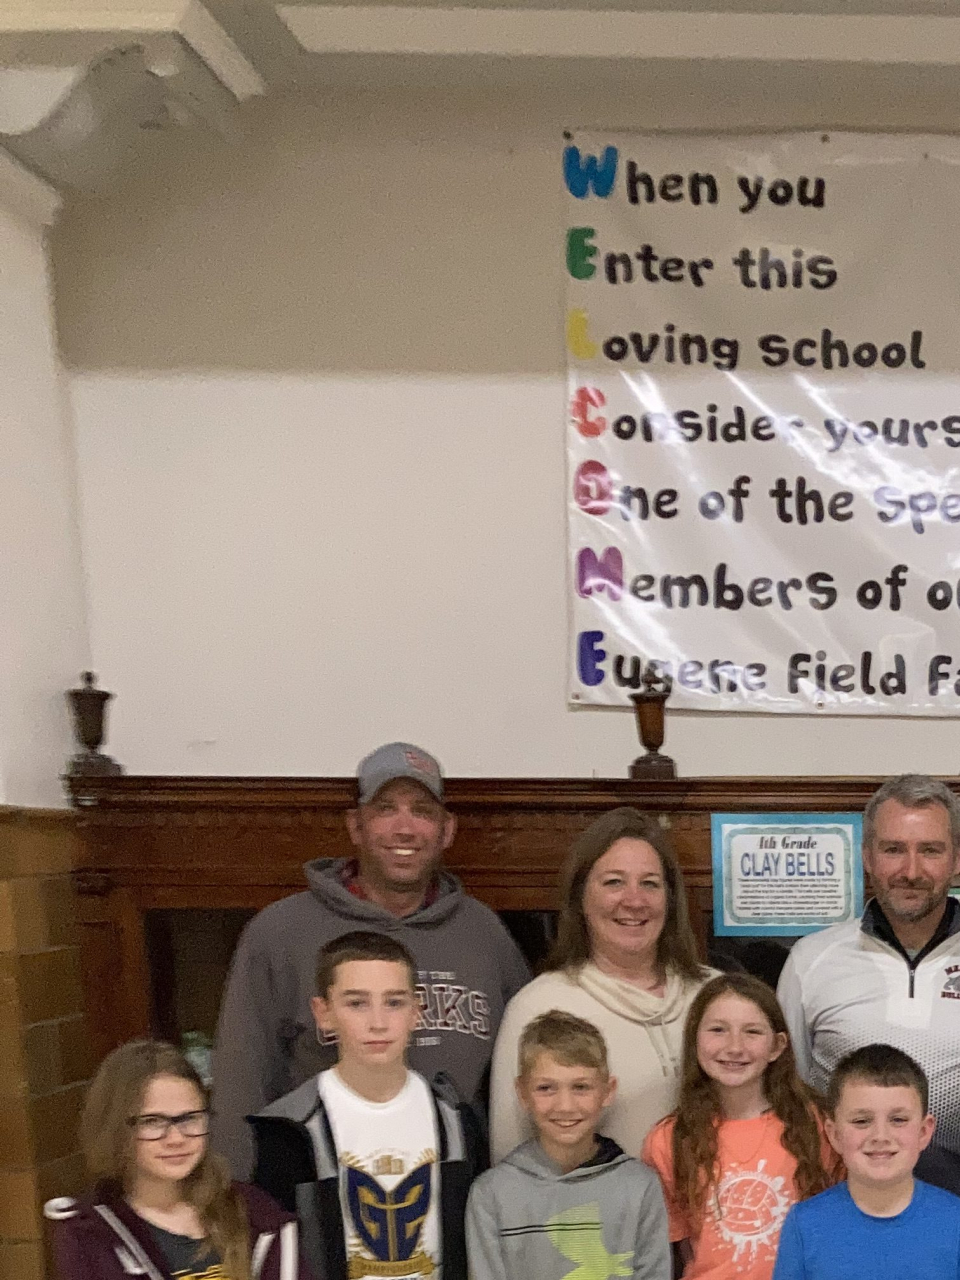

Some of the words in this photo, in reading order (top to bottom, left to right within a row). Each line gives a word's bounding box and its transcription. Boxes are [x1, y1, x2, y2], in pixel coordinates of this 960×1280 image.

[563, 145, 719, 205] When
[737, 174, 827, 214] you
[565, 226, 715, 288] Enter
[733, 246, 838, 291] this
[566, 308, 740, 372] Loving
[758, 328, 926, 371] school
[574, 459, 679, 522] One
[699, 475, 752, 523] of
[769, 476, 855, 527] the
[576, 546, 839, 612] Members
[856, 564, 910, 612] of
[578, 630, 768, 696] Eugene
[787, 650, 907, 697] Field
[740, 852, 781, 876] CLAY
[785, 852, 834, 876] BELLS
[781, 836, 818, 850] Grade
